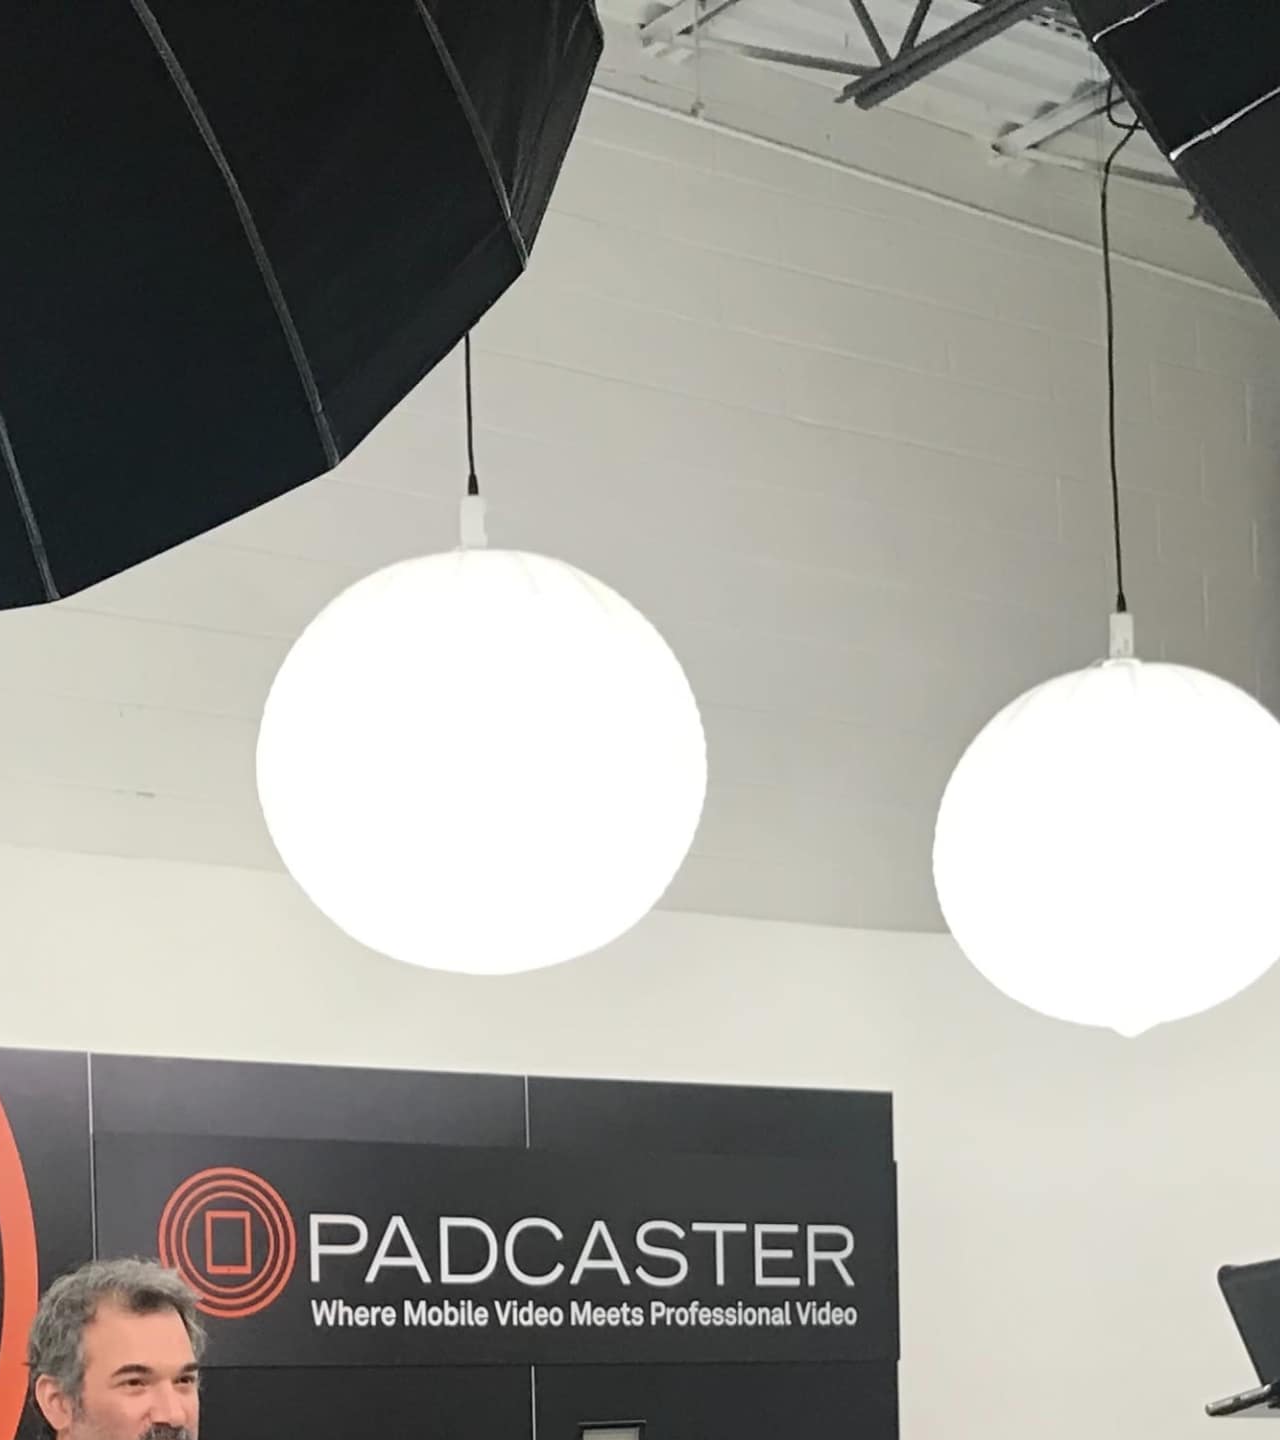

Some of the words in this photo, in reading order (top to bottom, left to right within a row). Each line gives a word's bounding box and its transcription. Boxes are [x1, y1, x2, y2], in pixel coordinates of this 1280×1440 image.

[309, 1213, 856, 1288] PADCASTER
[311, 1299, 397, 1327] Where
[403, 1300, 489, 1327] Mobile
[494, 1300, 564, 1327] Video
[570, 1301, 644, 1327] Meets
[650, 1301, 792, 1327] Professional
[796, 1301, 858, 1327] Video
